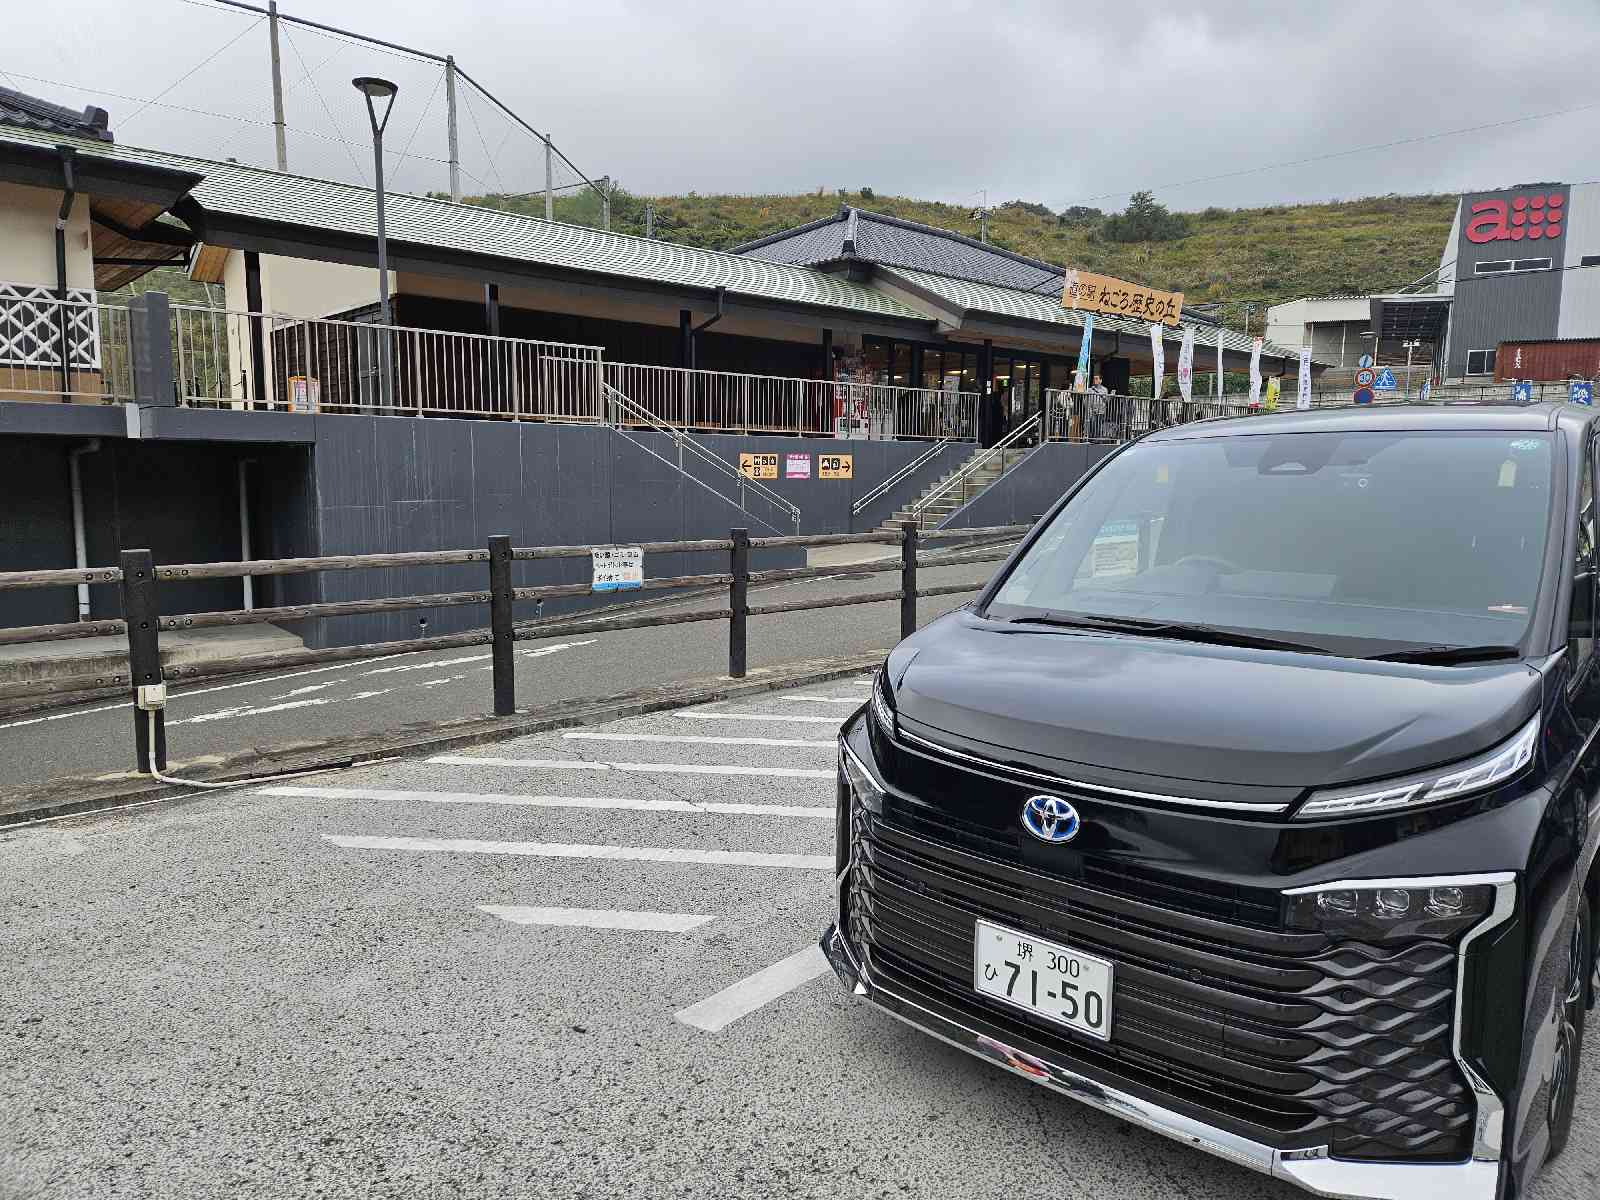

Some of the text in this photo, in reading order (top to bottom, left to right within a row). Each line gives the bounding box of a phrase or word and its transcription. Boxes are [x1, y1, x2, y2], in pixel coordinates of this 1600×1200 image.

[1098, 285, 1176, 319] ねごろ歴史の丘
[1017, 940, 1080, 978] 堺 300
[984, 959, 1103, 1029] ひ 71-50
